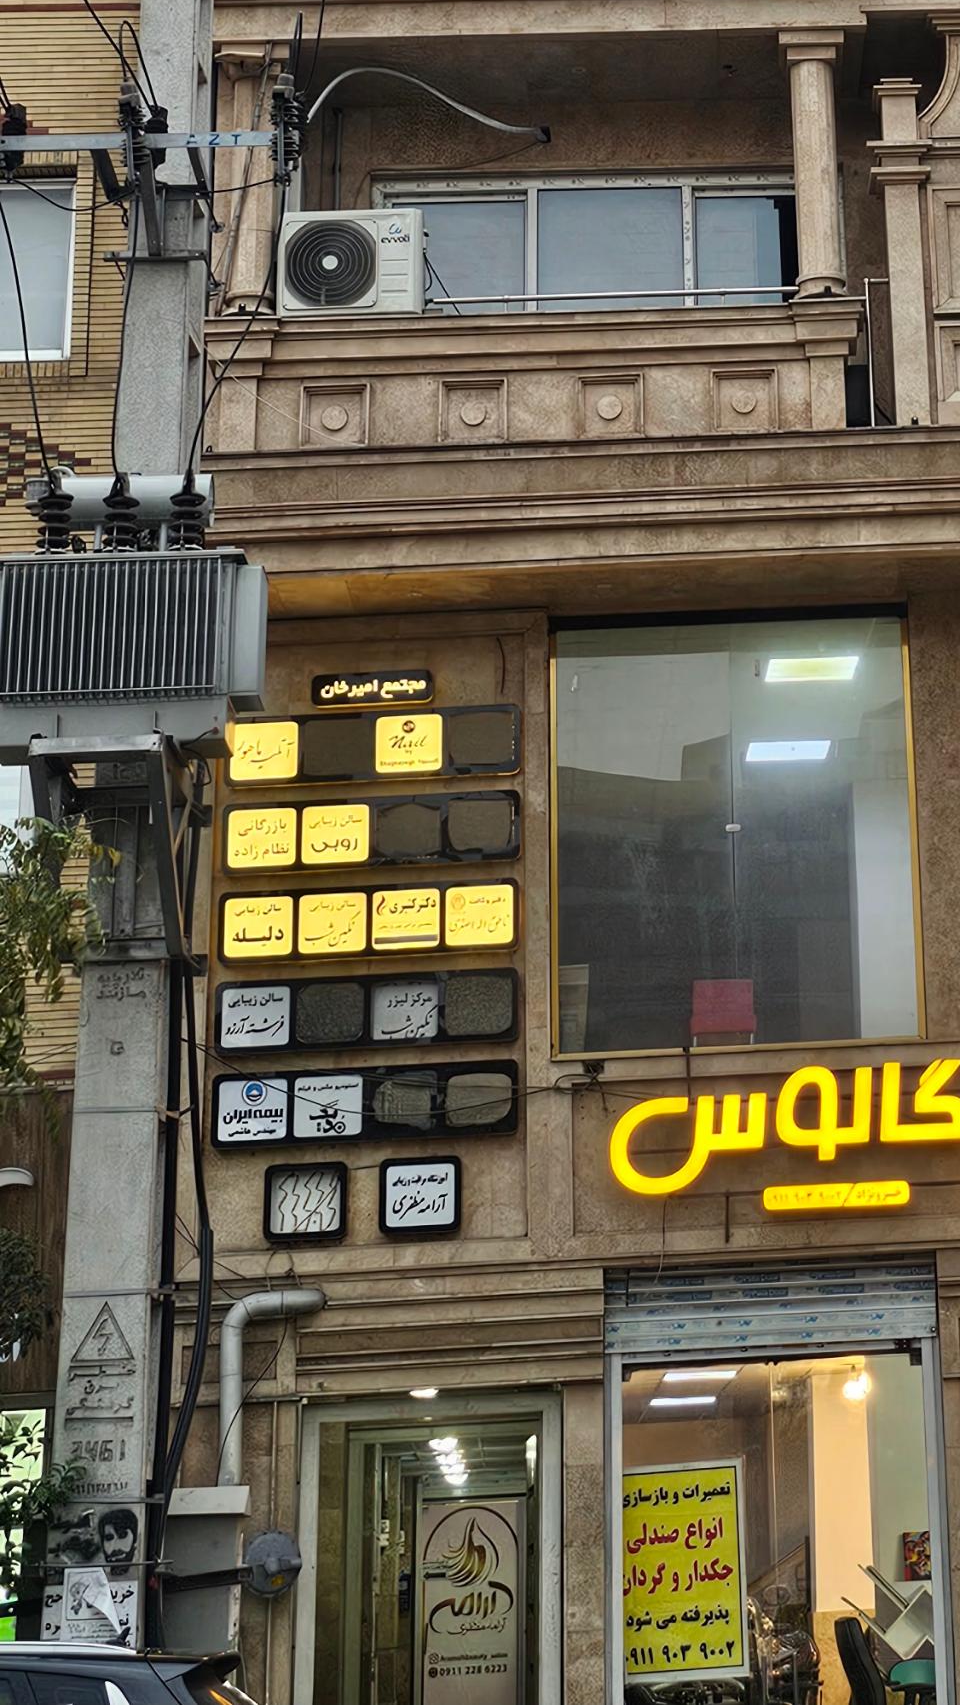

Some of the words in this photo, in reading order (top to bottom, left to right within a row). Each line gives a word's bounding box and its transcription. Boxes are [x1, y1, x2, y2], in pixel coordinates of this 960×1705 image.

[380, 679, 427, 699] مجتمع
[238, 818, 288, 837] بازرگانی
[340, 814, 363, 827] سالن
[234, 844, 260, 861] زاده
[262, 842, 290, 860] نظام
[311, 837, 359, 853] روبی
[262, 903, 282, 915] سالن
[336, 900, 357, 911] سالن
[416, 896, 437, 912] دکتر
[228, 994, 258, 1008] زیبایی
[259, 992, 284, 1006] سالن
[386, 992, 409, 1008] لیزر
[409, 991, 433, 1007] مرکز
[222, 1108, 252, 1125] ایران
[253, 1108, 284, 1123] بیمه
[228, 1127, 251, 1138] هاشمی
[252, 1126, 277, 1137] مهندس
[68, 1364, 137, 1382] خطر
[84, 1380, 120, 1395] برق
[66, 1396, 135, 1416] گرفتگی
[623, 1486, 670, 1508] بازسازی
[672, 1490, 679, 1505] و
[682, 1481, 731, 1503] تعمیرات
[626, 1522, 680, 1555] صندلی
[684, 1516, 724, 1550] انواع
[671, 1571, 680, 1593] و
[685, 1557, 734, 1592] جکدار
[626, 1610, 653, 1632] شود
[655, 1613, 677, 1630] می
[681, 1605, 730, 1627] پذیرفته
[661, 1644, 692, 1664] ۹۰۳
[699, 1640, 735, 1659] ۹۰۰۲
